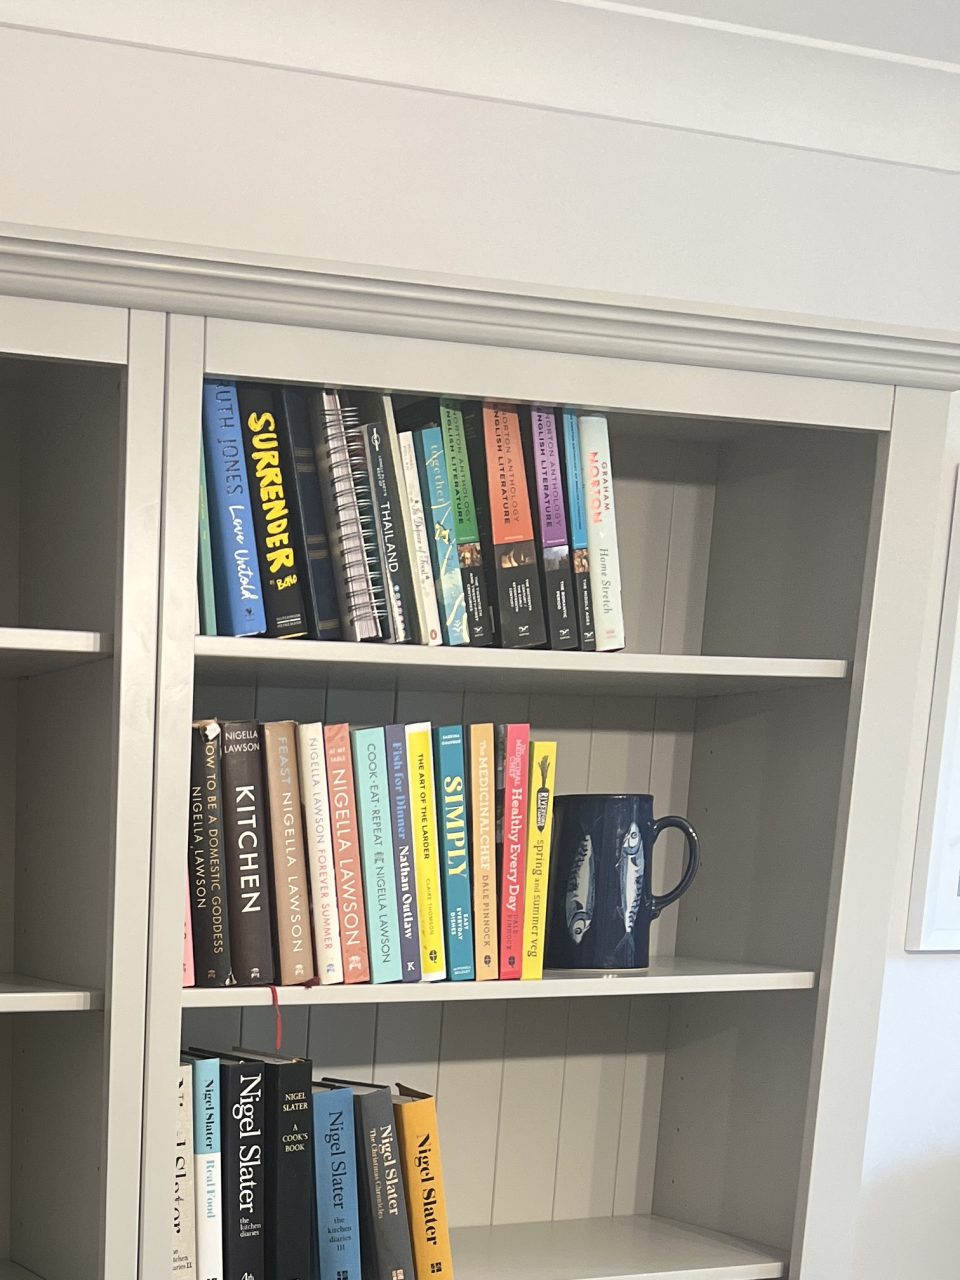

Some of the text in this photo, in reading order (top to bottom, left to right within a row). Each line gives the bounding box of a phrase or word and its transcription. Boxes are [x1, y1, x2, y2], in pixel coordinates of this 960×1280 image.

[217, 437, 243, 496] JONES
[247, 411, 295, 574] SURRENDER
[589, 451, 603, 525] NORTON
[601, 461, 610, 511] GRAHAM
[228, 505, 259, 600] Love Untold
[379, 501, 400, 573] THAILAND
[276, 574, 298, 591] BONO
[599, 548, 613, 614] Home Stretch
[224, 742, 260, 753] LAWSON
[225, 728, 259, 740] NIGELLA
[417, 753, 430, 860] THE ART OF THE LARDER
[443, 776, 468, 880] SIMPLY
[235, 785, 261, 913] KITCHEN
[332, 769, 361, 945] NIGELLA LAWSON
[506, 788, 523, 912] Healthy Every Day
[399, 845, 413, 940] Nathan Outlaw
[283, 1102, 308, 1111] SLATER
[285, 1093, 306, 1102] NIGEL
[231, 1073, 262, 1213] Nigel Slater
[282, 1133, 308, 1143] COOK'S
[285, 1143, 305, 1152] BOOK
[324, 1111, 347, 1210] Nigel Slater
[378, 1124, 399, 1216] Nigel Slater
[206, 1160, 216, 1219] Real Food
[414, 1133, 438, 1246] Nigel Slater
